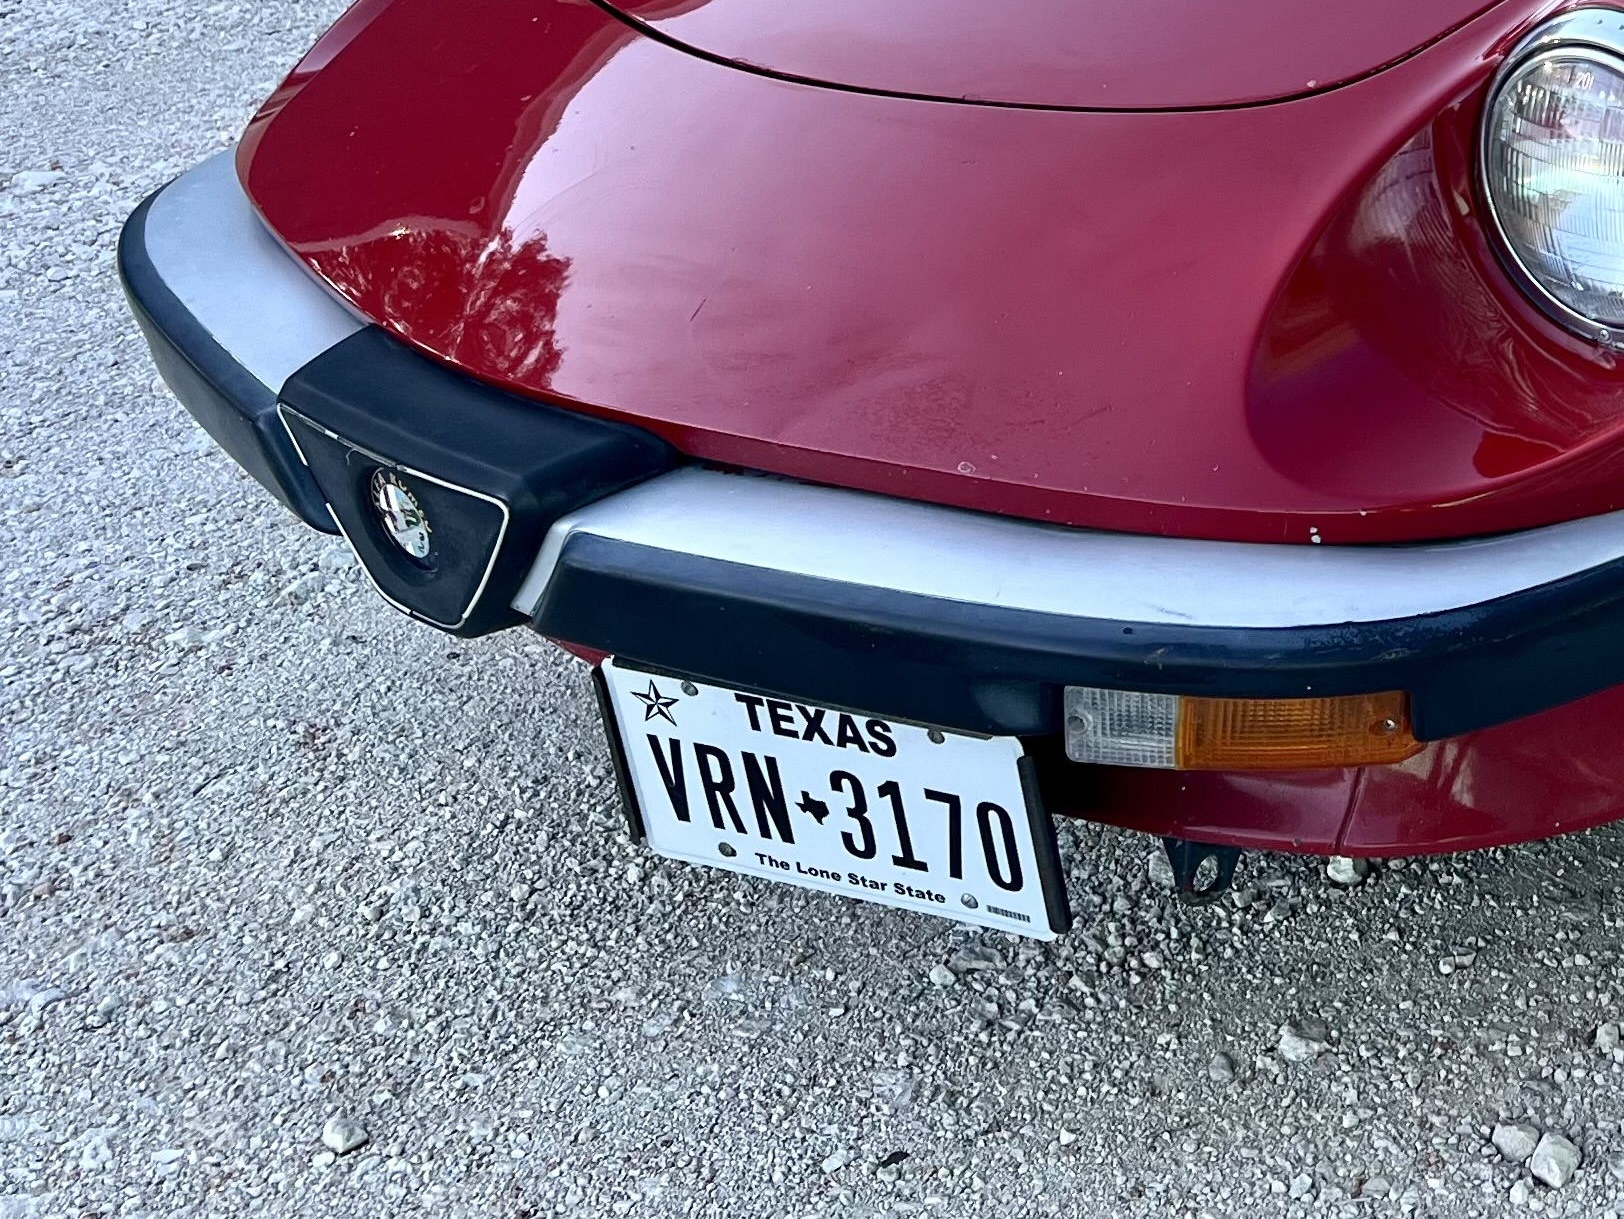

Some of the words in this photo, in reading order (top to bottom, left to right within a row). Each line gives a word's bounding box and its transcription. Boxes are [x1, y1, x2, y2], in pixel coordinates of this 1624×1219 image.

[735, 692, 897, 758] TEXAS
[754, 852, 790, 871] The
[796, 861, 842, 882] Lone
[847, 872, 888, 892] Star
[893, 882, 946, 904] State
